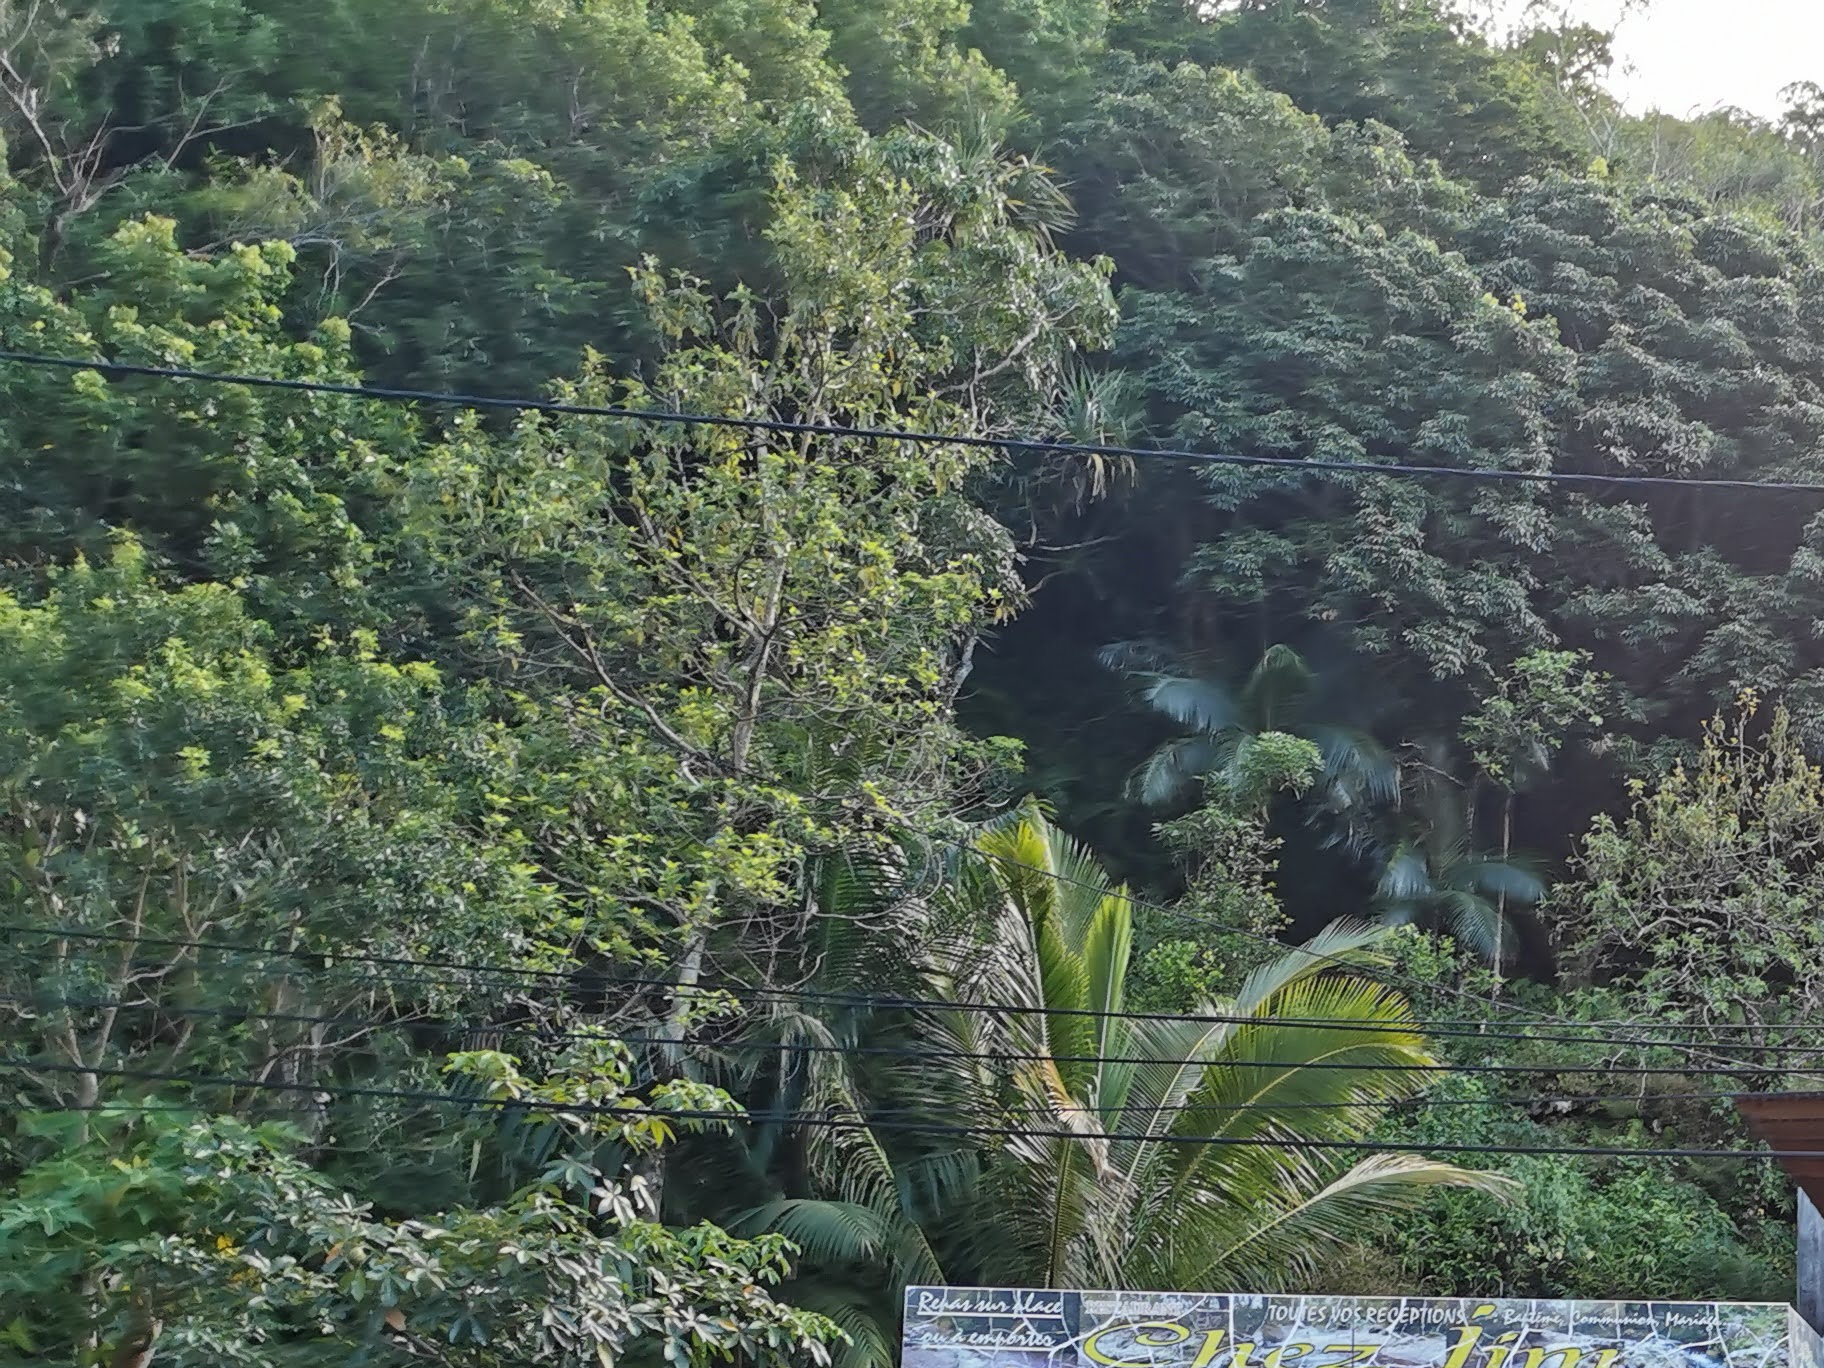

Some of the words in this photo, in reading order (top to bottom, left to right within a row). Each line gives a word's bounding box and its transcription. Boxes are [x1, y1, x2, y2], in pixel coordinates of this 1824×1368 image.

[918, 1292, 974, 1313] Repas
[1268, 1304, 1327, 1322] TOUTES
[1331, 1306, 1361, 1323] VOS
[1366, 1306, 1464, 1325] RECEPTIONS
